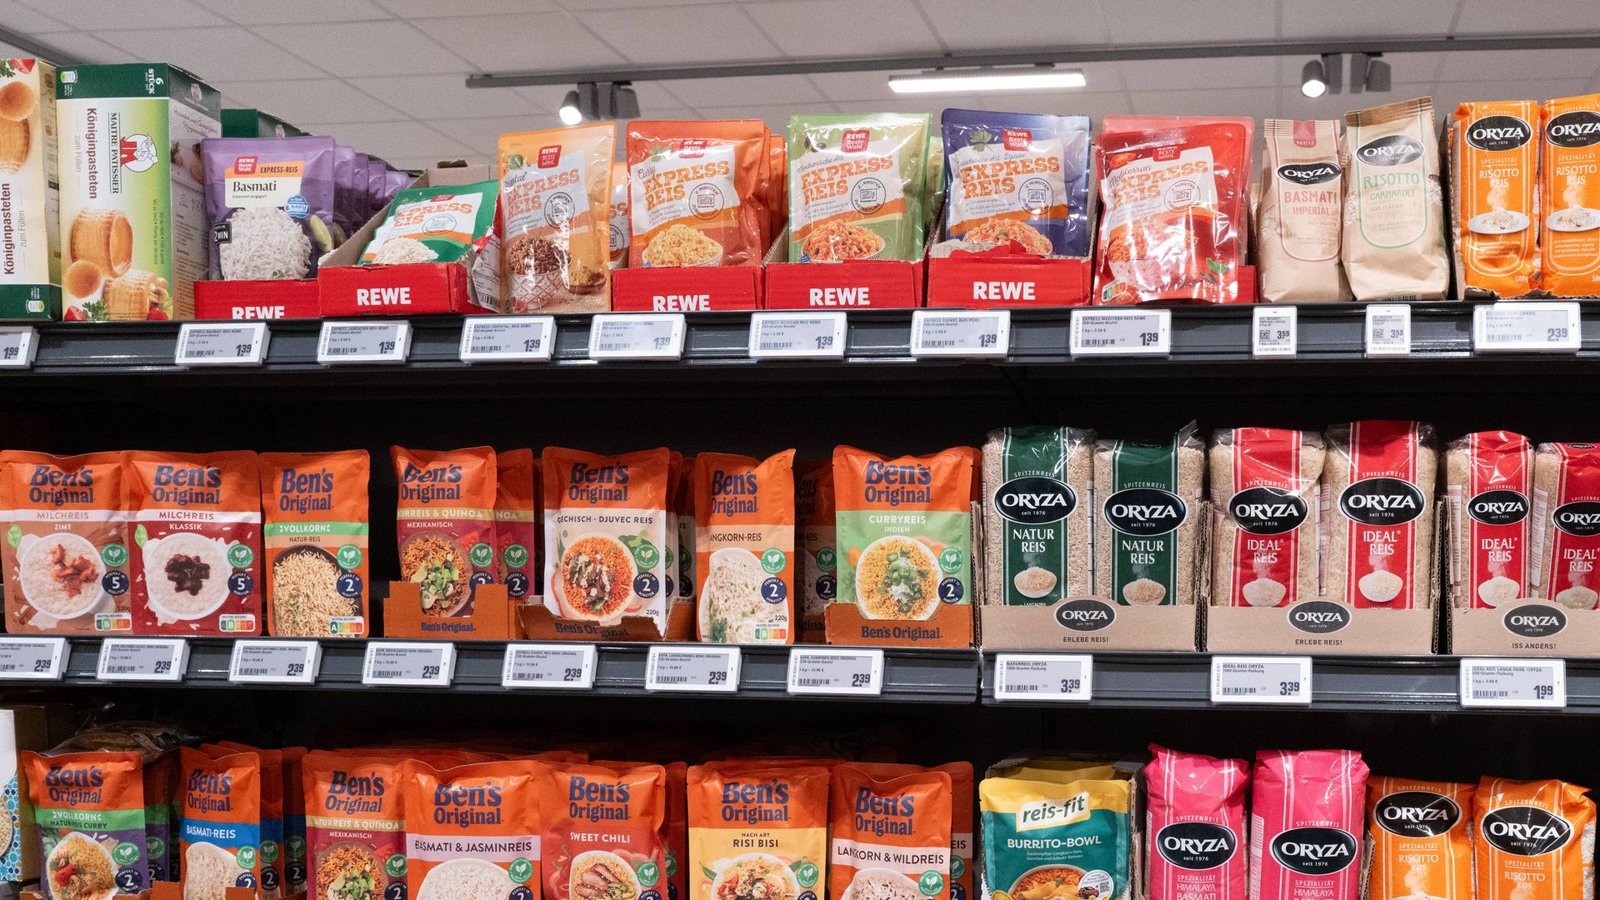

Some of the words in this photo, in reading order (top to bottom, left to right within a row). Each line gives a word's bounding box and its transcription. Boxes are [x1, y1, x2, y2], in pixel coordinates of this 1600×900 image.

[148, 68, 156, 94] STÜCK
[1472, 127, 1525, 141] ORYZA
[1551, 122, 1600, 136] ORYZA
[86, 108, 98, 199] Königinpasteten
[1363, 144, 1416, 157] ORYZA
[111, 149, 119, 195] PATISSIER
[260, 166, 299, 174] EXPRESS-REIS
[801, 155, 894, 191] EXPRESS
[960, 156, 1060, 184] EXPRESS
[1283, 167, 1335, 179] ORYZA
[1479, 168, 1520, 179] RISOTTO
[1556, 164, 1597, 176] RISOTTO
[233, 180, 277, 192] Basmati
[963, 177, 1016, 200] REIS
[1363, 173, 1420, 190] RISOTTO
[803, 179, 849, 206] REIS
[1283, 190, 1338, 205] BASMATI
[1292, 207, 1331, 216] IMPERIAL
[18, 210, 26, 232] Füllen
[3, 183, 15, 275] Königinpasteten
[357, 287, 412, 306] REWE
[809, 287, 871, 306] REWE
[973, 281, 1036, 300] REWE
[653, 294, 711, 312] REWE
[523, 339, 541, 352] 1.39
[653, 336, 671, 350] 1.39
[815, 336, 834, 350] 1.39
[978, 334, 997, 348] 1.39
[1140, 332, 1159, 346] 1.39
[236, 344, 252, 357] 1.39
[379, 341, 396, 355] 1.39
[30, 465, 94, 488] Ben's
[154, 465, 223, 488] Ben's
[402, 463, 462, 484] Ben's
[570, 463, 630, 485] Ben's
[865, 460, 932, 485] Ben's
[280, 468, 334, 494] Ben's
[712, 470, 758, 496] Ben's
[29, 487, 94, 506] Original
[152, 487, 220, 506] Original
[401, 484, 461, 503] Original
[568, 485, 628, 504] Original
[865, 486, 931, 507] Original
[279, 494, 332, 514] Original
[1001, 493, 1068, 510] ORYZA
[1348, 494, 1417, 511] ORYZA
[1474, 501, 1524, 515] ORYZA
[36, 512, 89, 520] MILCHREIS
[159, 511, 214, 520] MILCHREIS
[442, 510, 483, 519] QUINOA
[1111, 504, 1178, 521] ORYZA
[1235, 503, 1299, 520] ORYZA
[599, 515, 631, 524] DJUVEC
[634, 516, 653, 525] REIS
[868, 515, 927, 524] CURRYREIS
[169, 523, 202, 531] KLASSIK
[284, 524, 327, 533] VOLLKORN
[1013, 528, 1055, 540] NATUR
[1363, 530, 1398, 543] IDEAL
[1021, 541, 1046, 553] REIS
[1122, 540, 1164, 552] NATUR
[1247, 539, 1281, 551] IDEAL
[1369, 544, 1395, 556] REIS
[1482, 538, 1515, 550] IDEAL
[1130, 553, 1156, 565] REIS
[1253, 552, 1278, 563] REIS
[1488, 550, 1513, 562] REIS
[1563, 548, 1597, 560] IDEAL
[1569, 561, 1594, 573] REIS
[346, 579, 355, 592] 2
[642, 579, 651, 592] 2
[770, 584, 779, 597] 2
[946, 584, 955, 597] 2
[1062, 610, 1109, 622] ORYZA
[1295, 611, 1344, 624] ORYZA
[1510, 615, 1560, 627] ORYZA
[421, 621, 441, 631] Ben's
[442, 622, 475, 633] Original
[861, 626, 891, 639] Ben's
[892, 627, 940, 641] Original
[34, 659, 51, 672] 2.39
[154, 660, 172, 674] 2.39
[287, 663, 304, 677] 2.39
[422, 665, 440, 679] 2.39
[564, 668, 582, 681] 2.39
[708, 671, 727, 685] 2.39
[852, 673, 871, 687] 2.39
[1061, 679, 1081, 693] 3.39
[1280, 681, 1300, 696] 3.39
[1533, 685, 1554, 699] 1.99
[45, 766, 104, 789] Ben's
[188, 768, 233, 796] Ben's
[328, 770, 385, 797] Ben's
[434, 781, 503, 807] Ben's
[569, 775, 630, 803] Ben's
[721, 778, 789, 805] Ben's
[48, 788, 103, 806] Original
[187, 793, 232, 814] Original
[856, 786, 915, 817] Ben's
[325, 795, 383, 815] Original
[1022, 795, 1085, 824] reis-fit
[434, 807, 502, 829] Original
[569, 802, 629, 823] Original
[721, 805, 789, 825] Original
[1176, 815, 1219, 823] SPITZENREIS
[1383, 805, 1449, 823] ORYZA
[186, 824, 236, 839] BASMATI-REIS
[855, 814, 913, 837] Original
[1489, 822, 1560, 840] ORYZA
[329, 831, 373, 839] MEXIKANISCH
[570, 832, 599, 842] SWEET
[601, 833, 631, 844] CHILI
[1007, 835, 1102, 849] BURRITO-BOWL
[455, 843, 463, 852] &
[465, 841, 532, 853] JASMINREIS
[733, 839, 754, 848] RISI
[758, 839, 779, 848] BISI
[1164, 836, 1229, 854] ORYZA
[1281, 841, 1350, 860] ORYZA
[883, 853, 891, 863] &
[893, 854, 944, 865] WILDREIS
[1398, 854, 1439, 863] RISOTTO
[1504, 860, 1545, 868] SPEZIALITÄT
[1295, 879, 1335, 887] SPEZIALITÄT
[1504, 871, 1546, 881] RISOTTO
[1176, 883, 1217, 891] HIMALAYA
[1294, 888, 1334, 897] HIMALAYA
[1176, 892, 1217, 900] BASMATI
